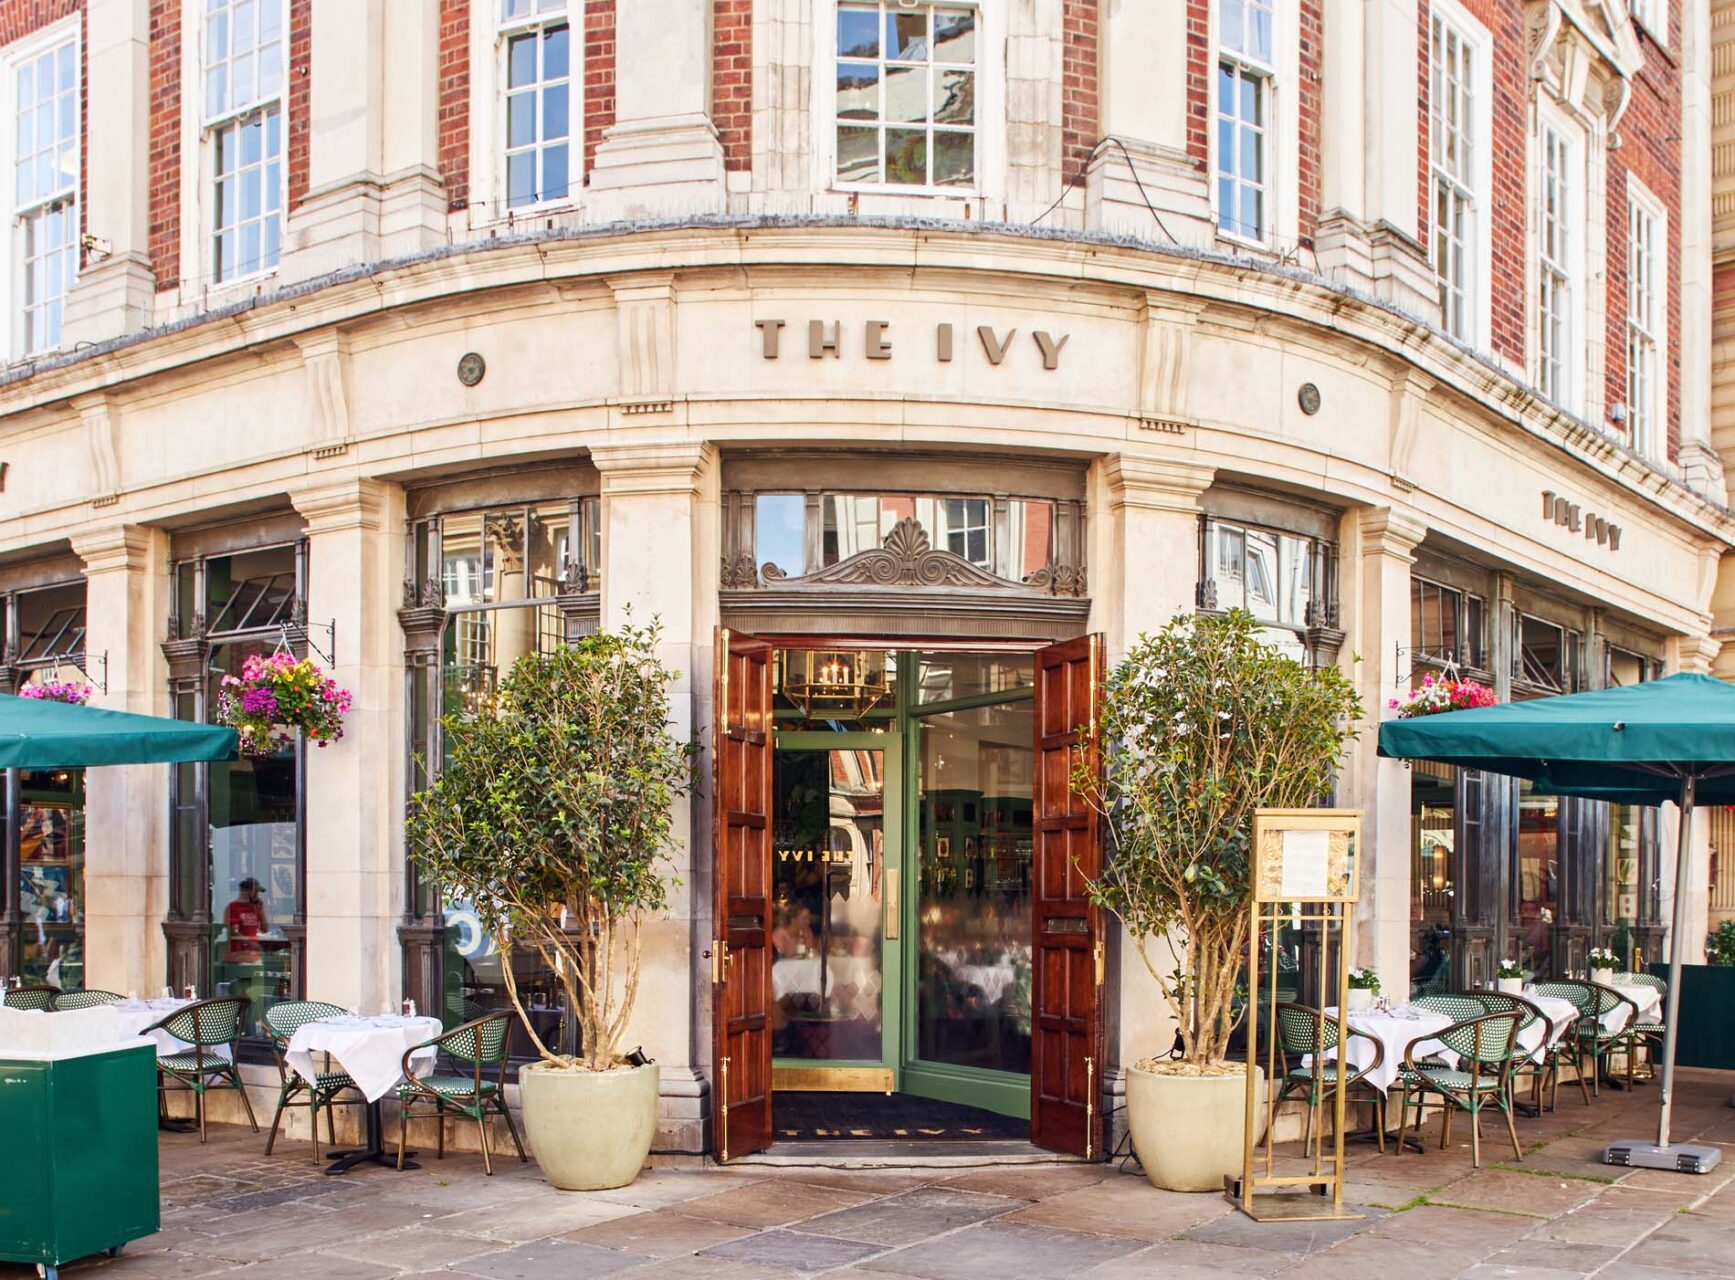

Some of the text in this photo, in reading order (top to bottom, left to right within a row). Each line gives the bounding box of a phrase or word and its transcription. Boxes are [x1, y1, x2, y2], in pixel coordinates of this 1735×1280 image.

[754, 319, 1071, 370] THE IVY
[1541, 490, 1622, 551] THE IVY
[779, 1128, 983, 1136] THE IVY
